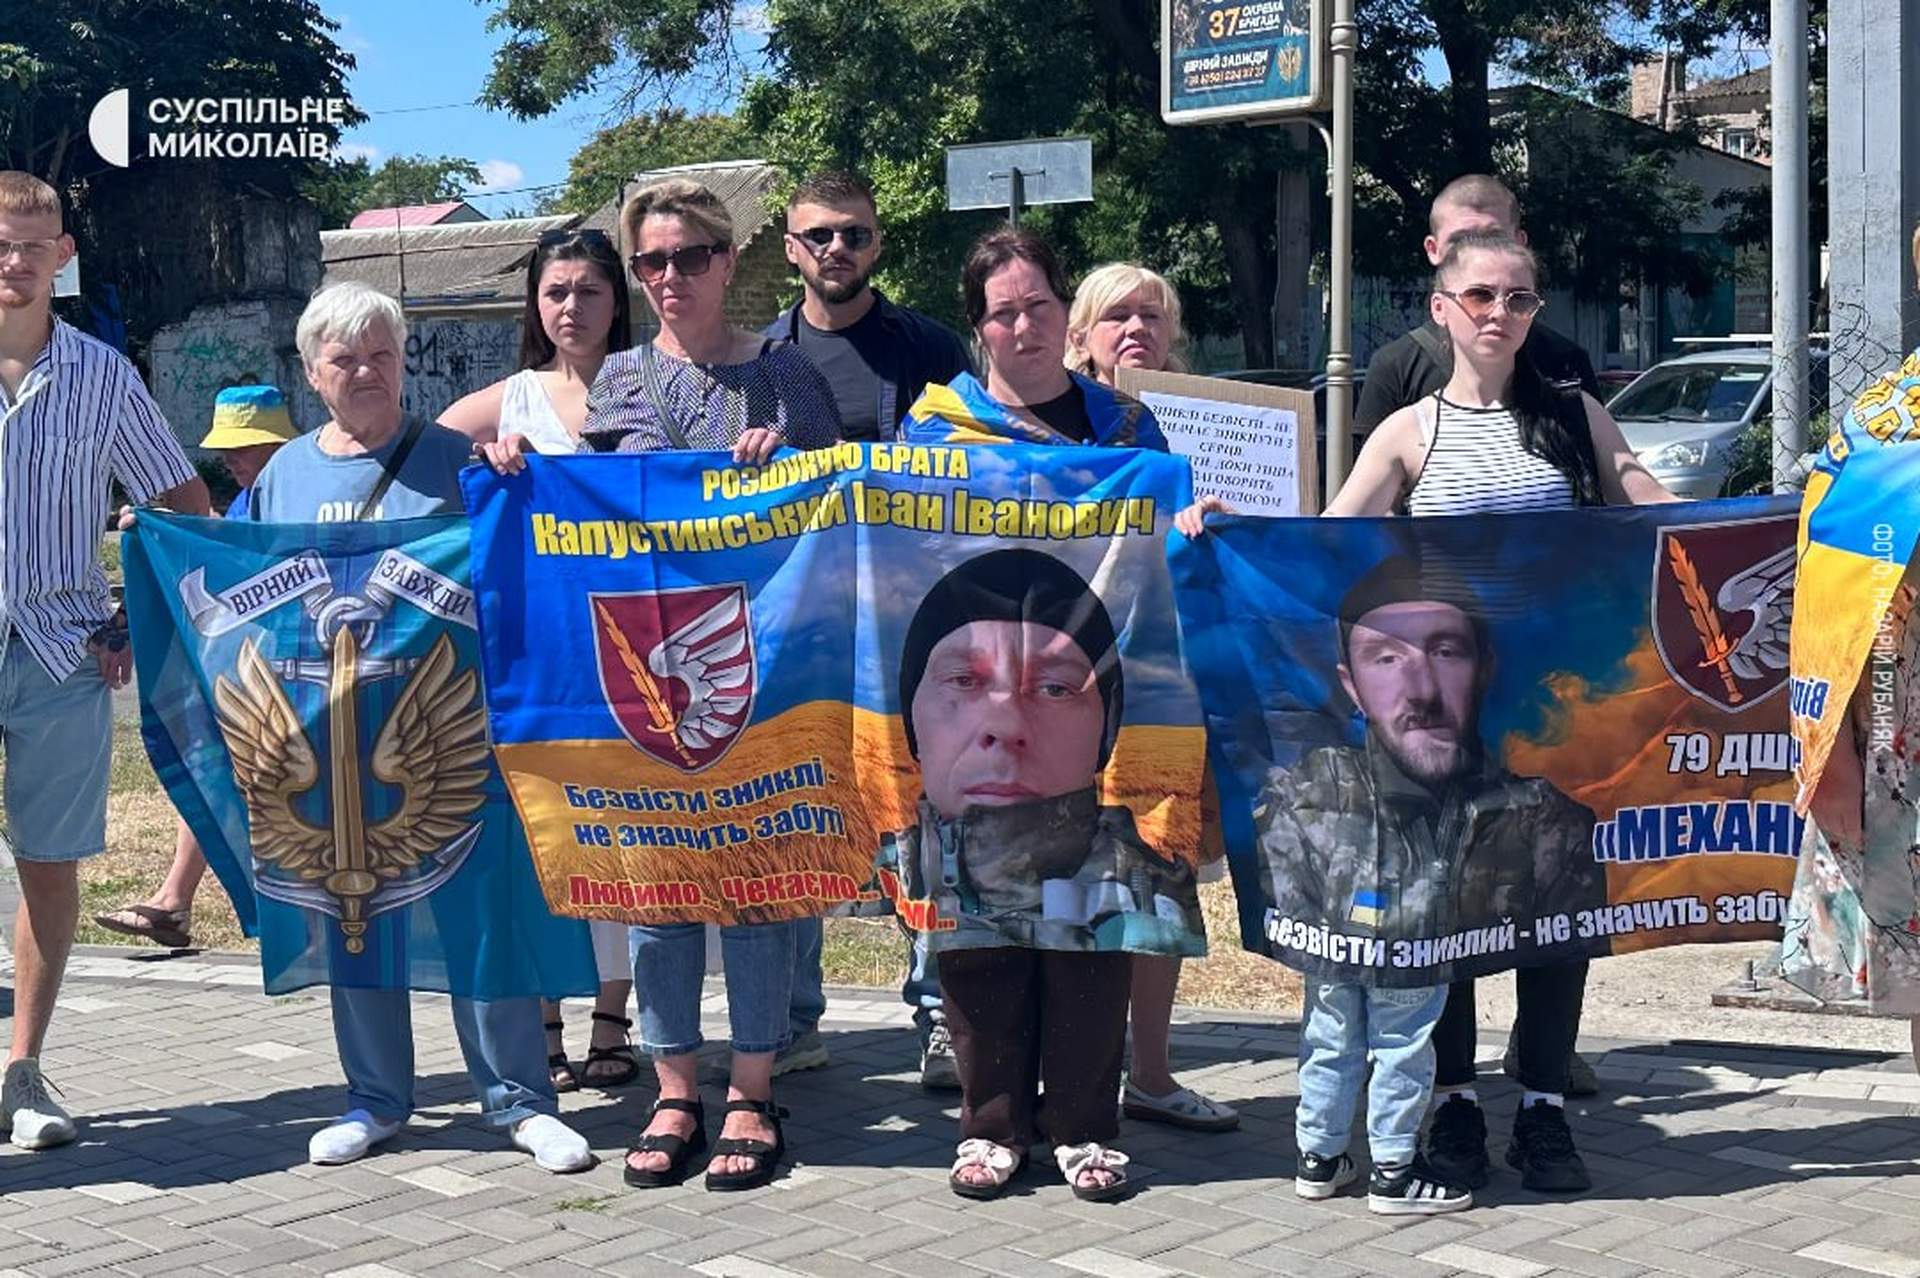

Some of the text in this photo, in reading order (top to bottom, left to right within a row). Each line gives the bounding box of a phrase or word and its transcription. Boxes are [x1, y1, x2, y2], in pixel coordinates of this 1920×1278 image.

[1209, 8, 1240, 38] 37
[702, 443, 970, 501] РОЗШУКУЮ БРАТА
[531, 480, 1156, 559] Капустинський Іван Іванович
[229, 557, 316, 617] ВІРНИЙ
[381, 556, 474, 616] ЗАВЖДИ
[1664, 734, 1707, 773] 79
[1715, 734, 1794, 778] ДШ
[564, 785, 706, 815] Безвісти
[712, 757, 825, 808] зниклі
[574, 823, 612, 848] не
[617, 822, 751, 851] значить
[1392, 916, 1516, 968] зниклий
[1535, 914, 1571, 947] не
[1575, 895, 1709, 939] значить
